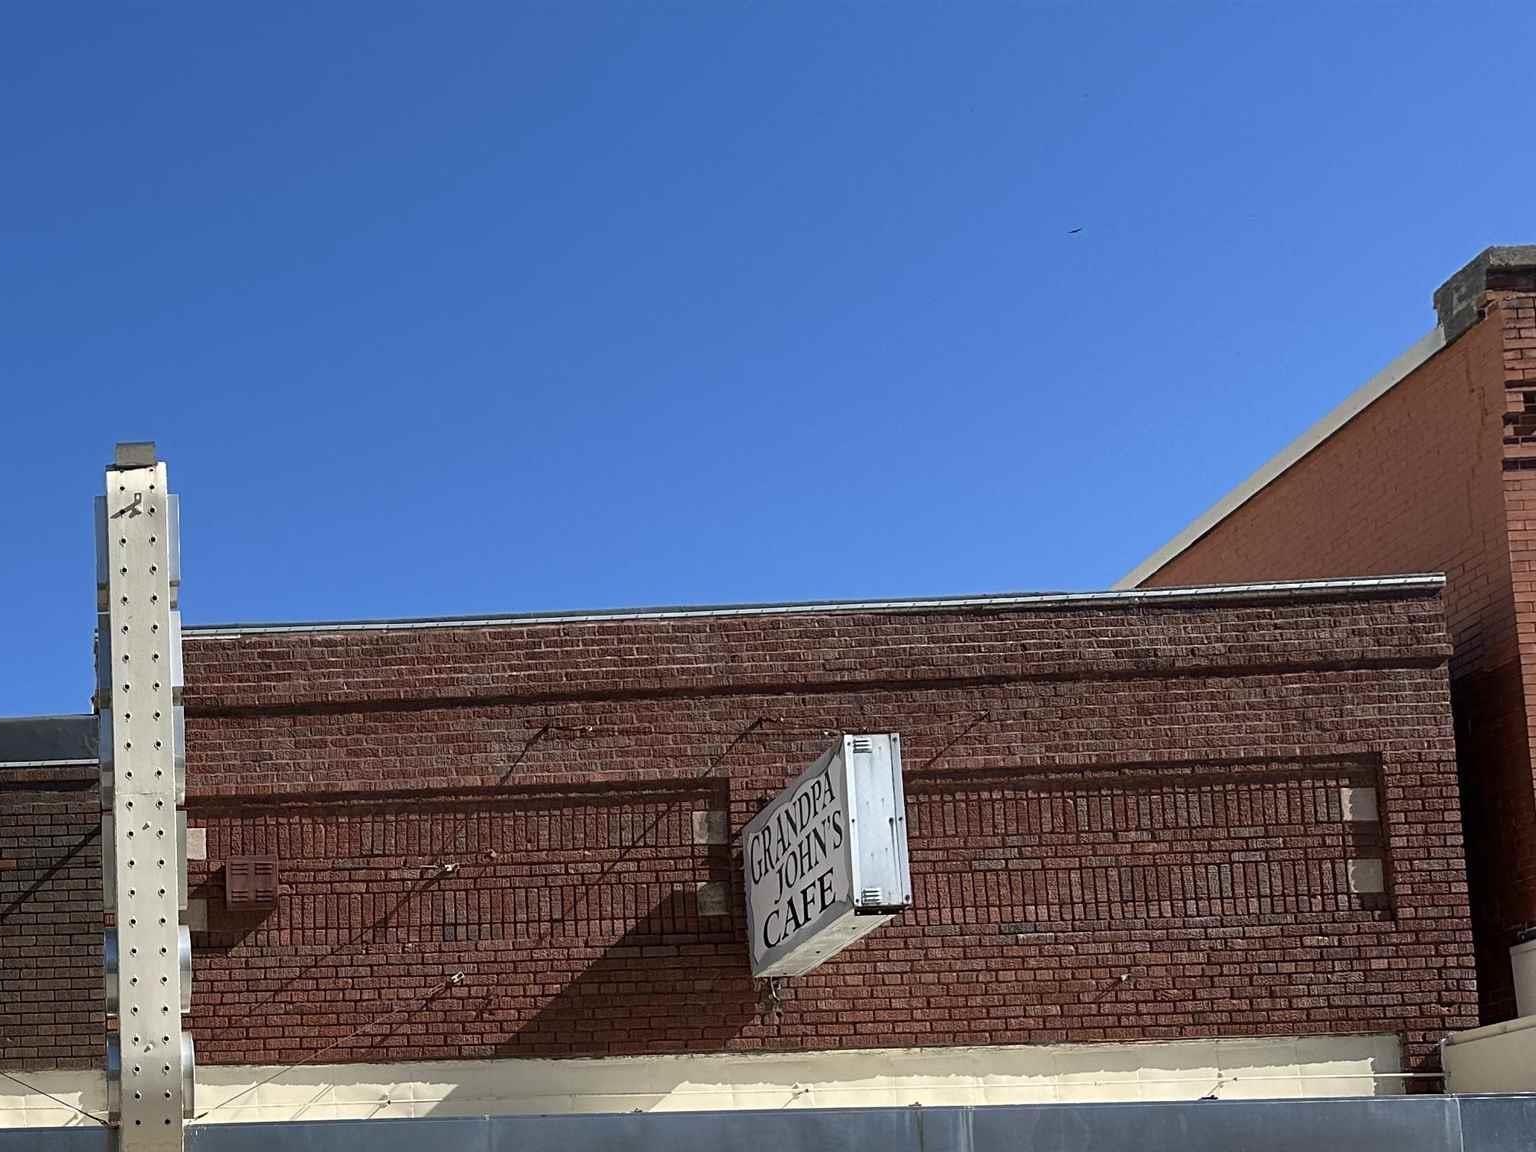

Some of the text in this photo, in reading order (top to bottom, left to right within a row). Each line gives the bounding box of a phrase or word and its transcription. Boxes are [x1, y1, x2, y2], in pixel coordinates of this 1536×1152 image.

[750, 771, 836, 885] GRANDPA
[774, 810, 844, 904] JOHN'S
[763, 867, 837, 948] CAFE
